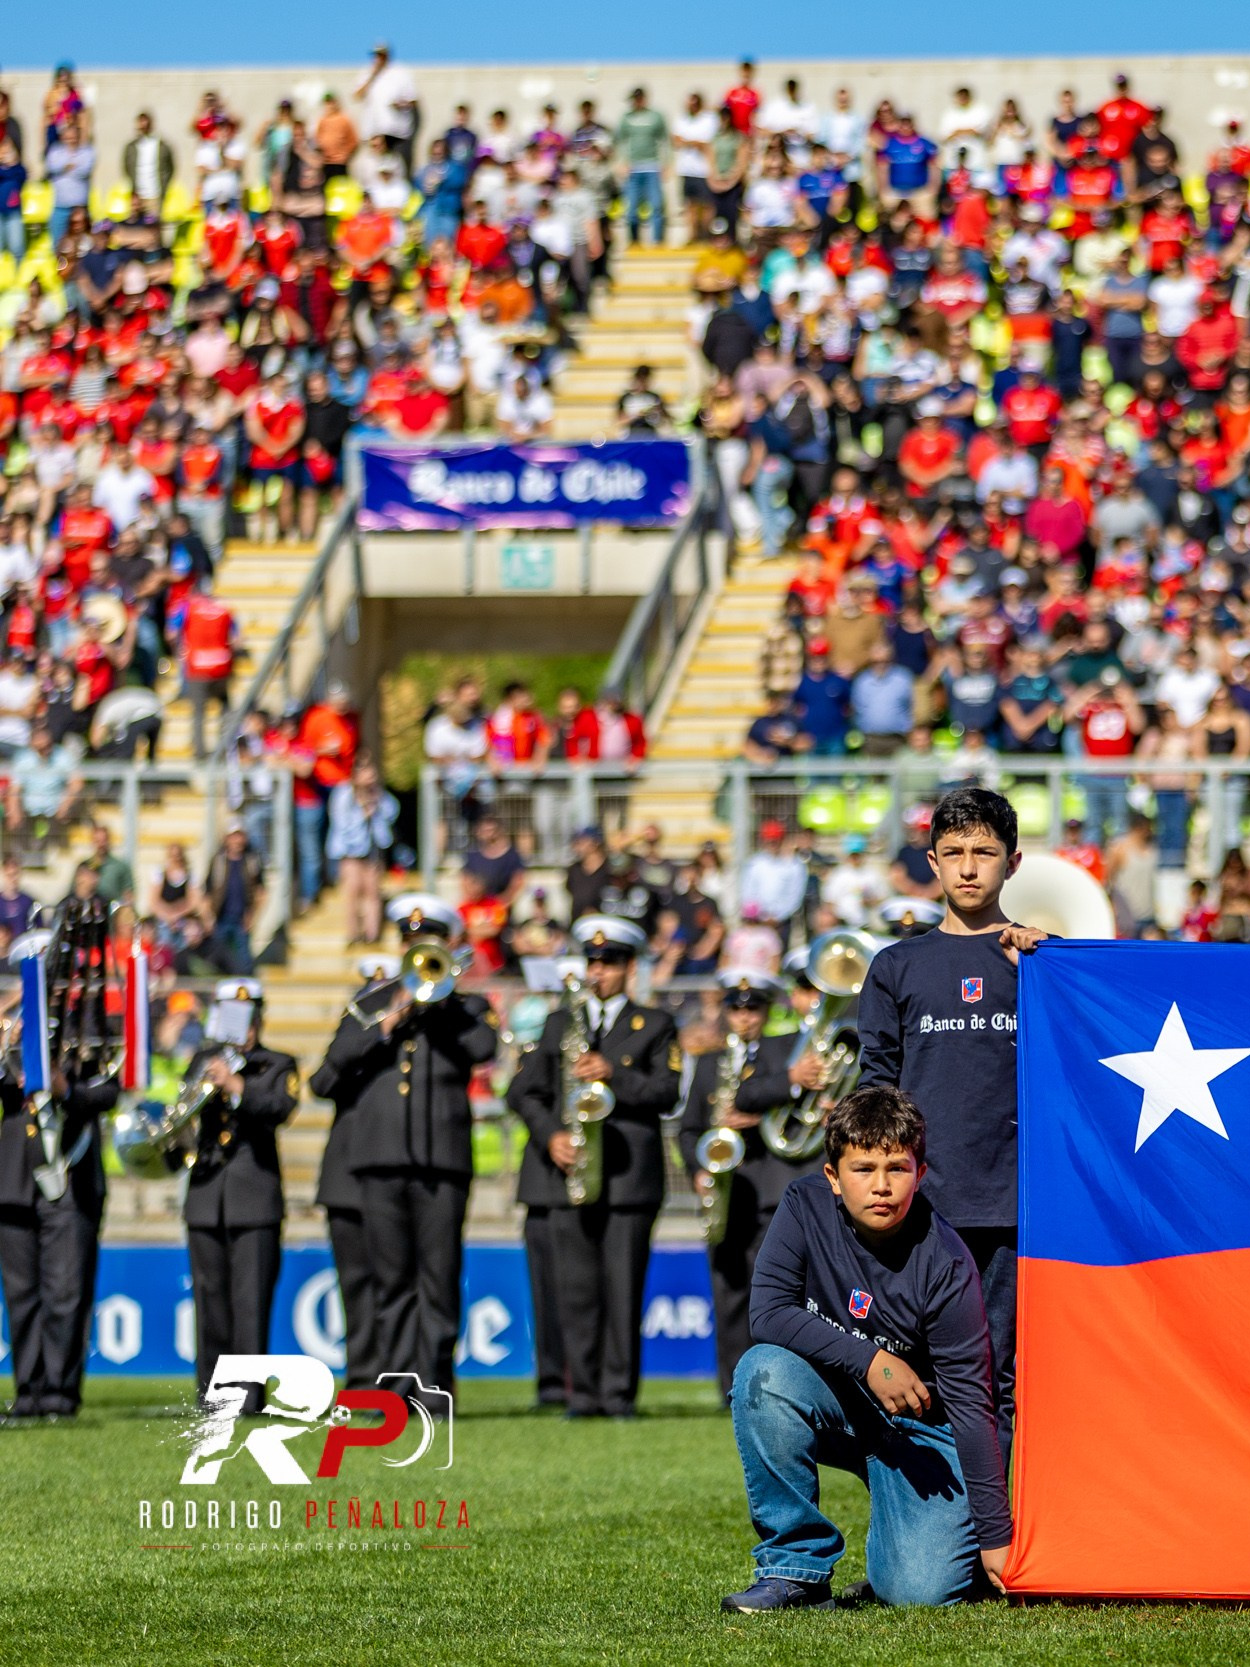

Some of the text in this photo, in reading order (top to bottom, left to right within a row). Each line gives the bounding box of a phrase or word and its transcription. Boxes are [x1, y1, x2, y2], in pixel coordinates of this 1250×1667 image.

[920, 1012, 1017, 1033] Banco de Chi
